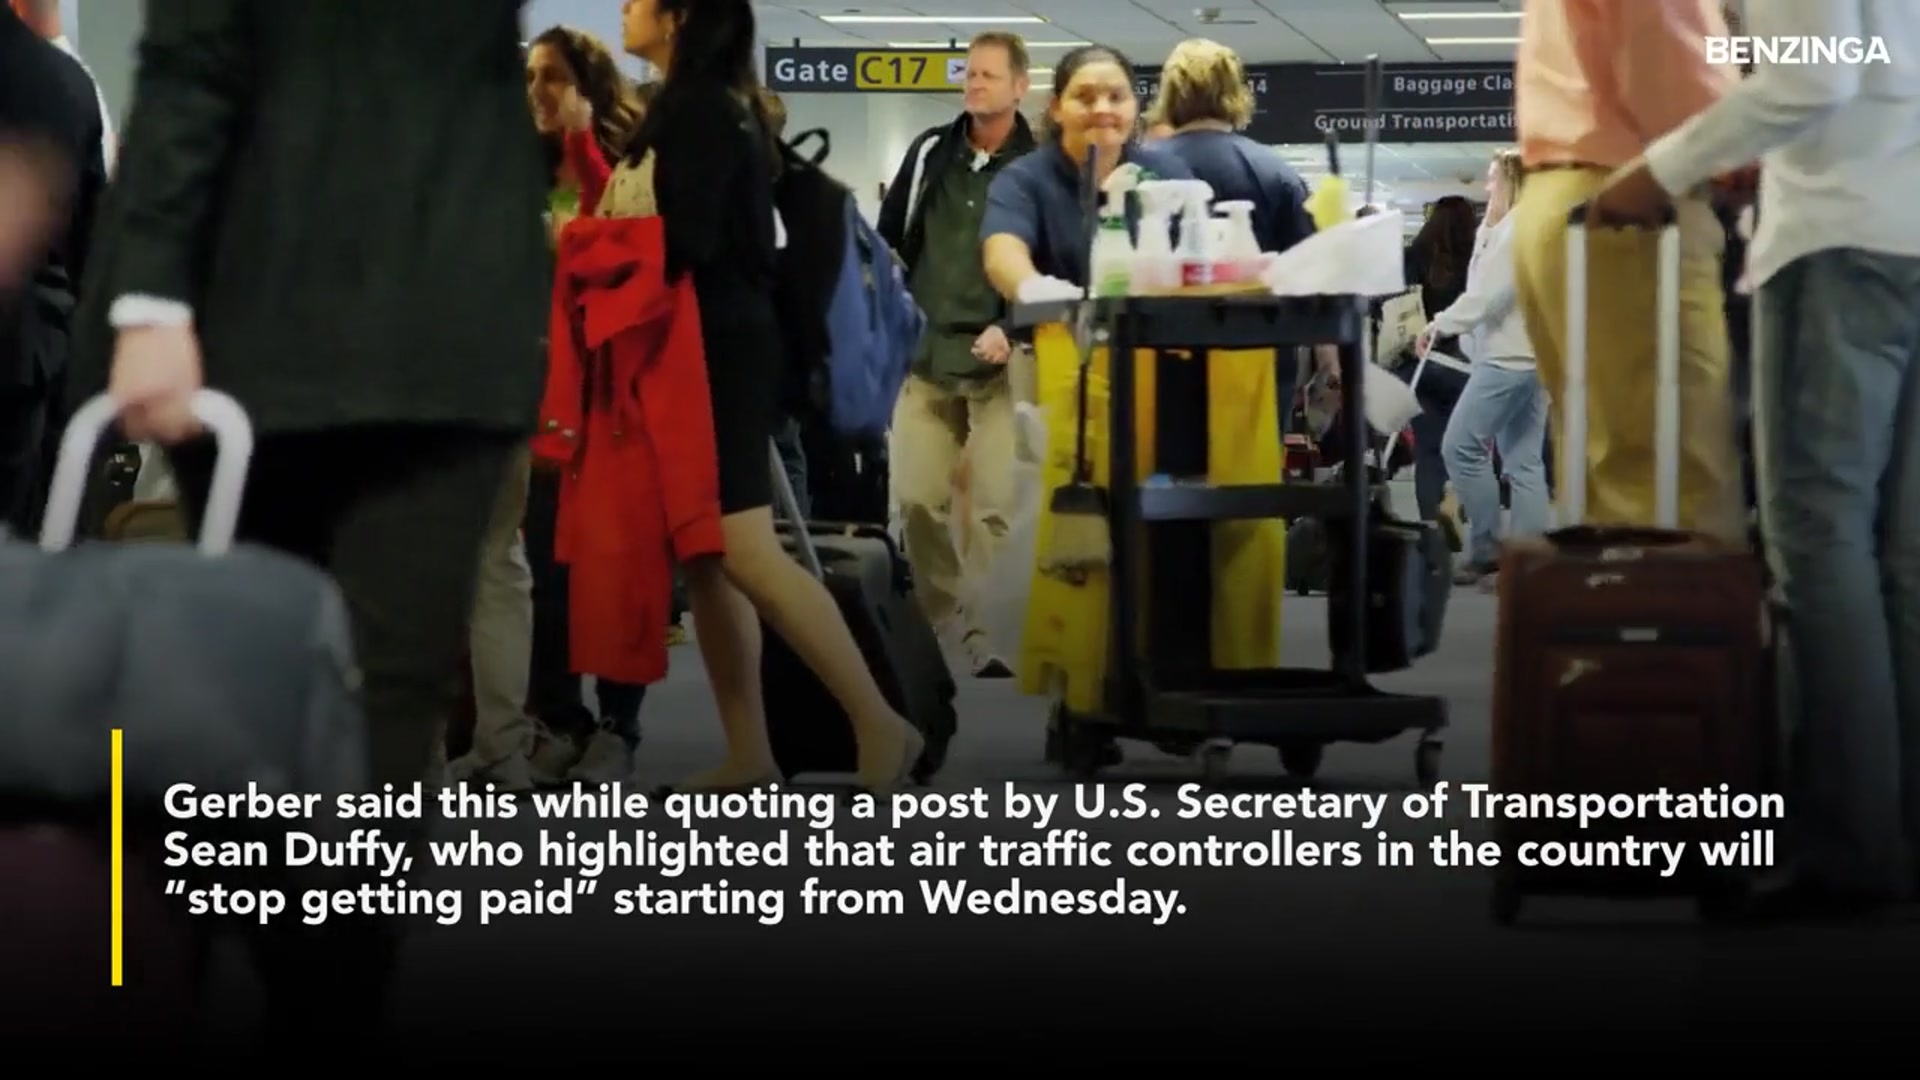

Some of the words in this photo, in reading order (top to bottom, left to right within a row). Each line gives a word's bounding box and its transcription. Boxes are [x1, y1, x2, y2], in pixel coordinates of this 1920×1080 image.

[774, 58, 849, 82] Gate
[860, 56, 928, 84] C17
[1393, 76, 1477, 95] Baggage
[1483, 75, 1514, 91] Cla
[1314, 113, 1386, 130] Ground
[1392, 113, 1517, 132] Transportati
